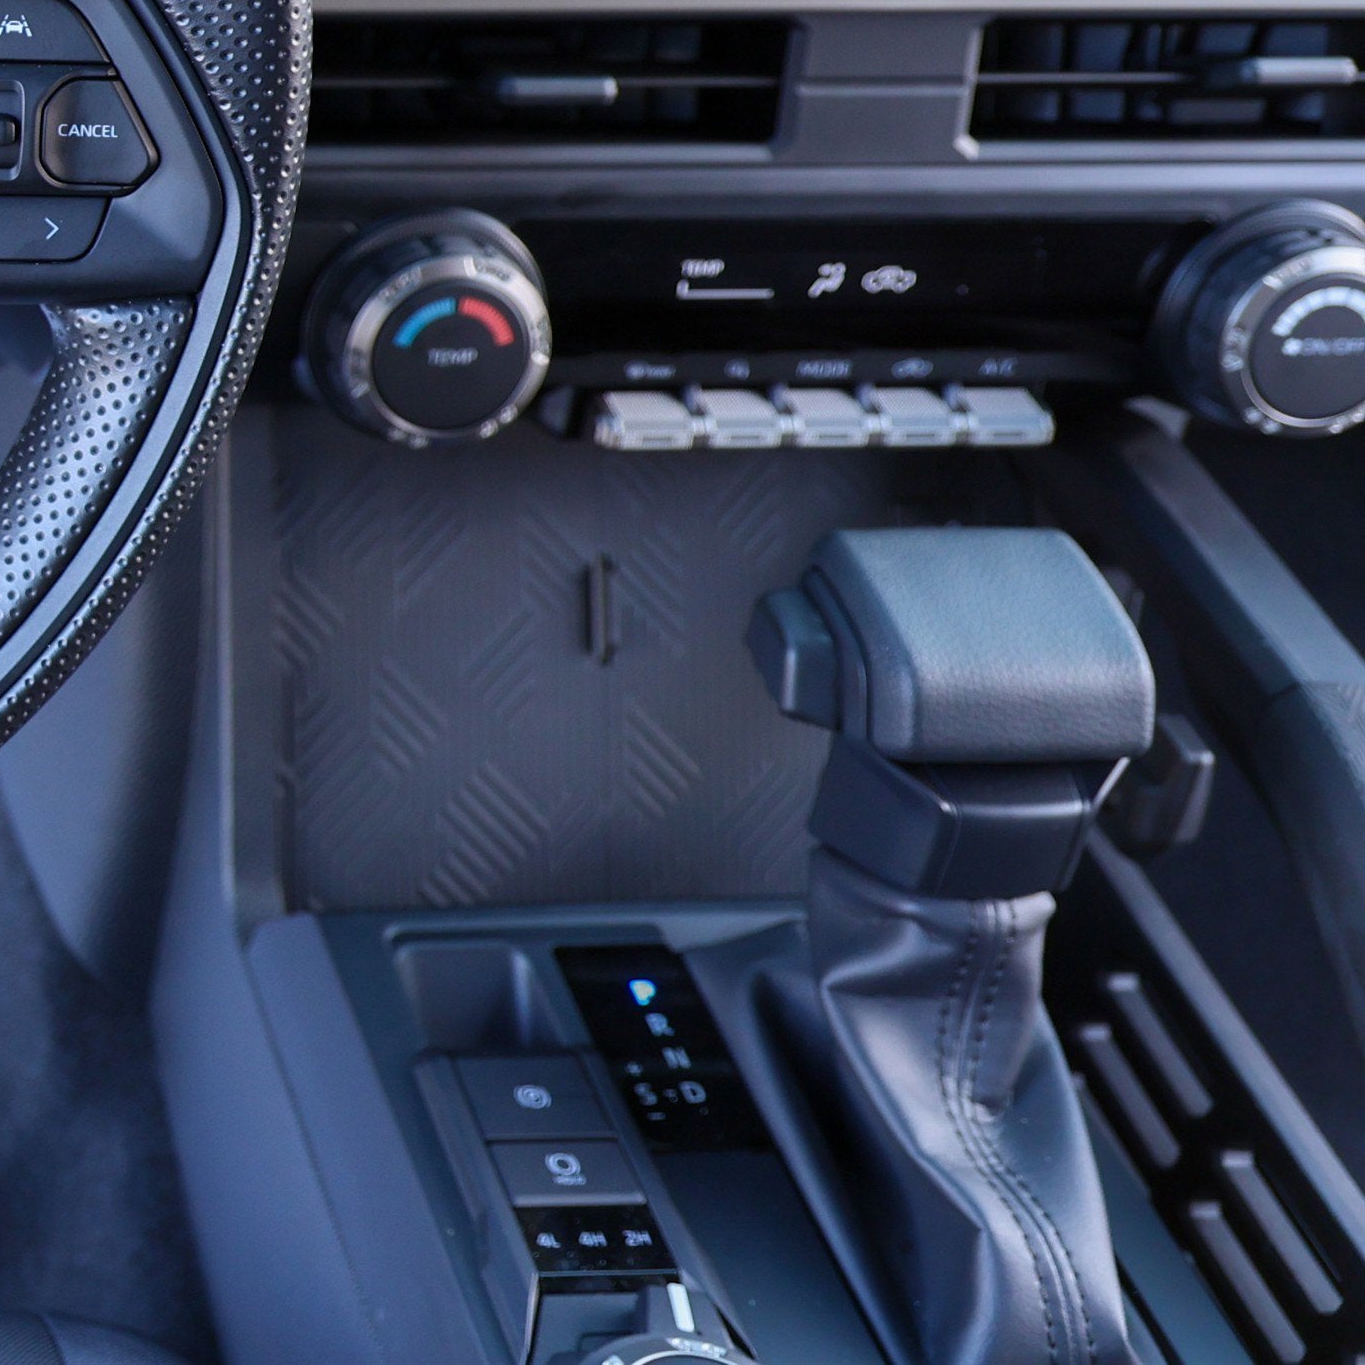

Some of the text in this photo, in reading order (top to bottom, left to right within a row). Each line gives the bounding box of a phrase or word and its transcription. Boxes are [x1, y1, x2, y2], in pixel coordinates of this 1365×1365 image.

[58, 123, 119, 139] CANCEL
[427, 347, 478, 366] TEMP
[678, 1081, 707, 1104] D
